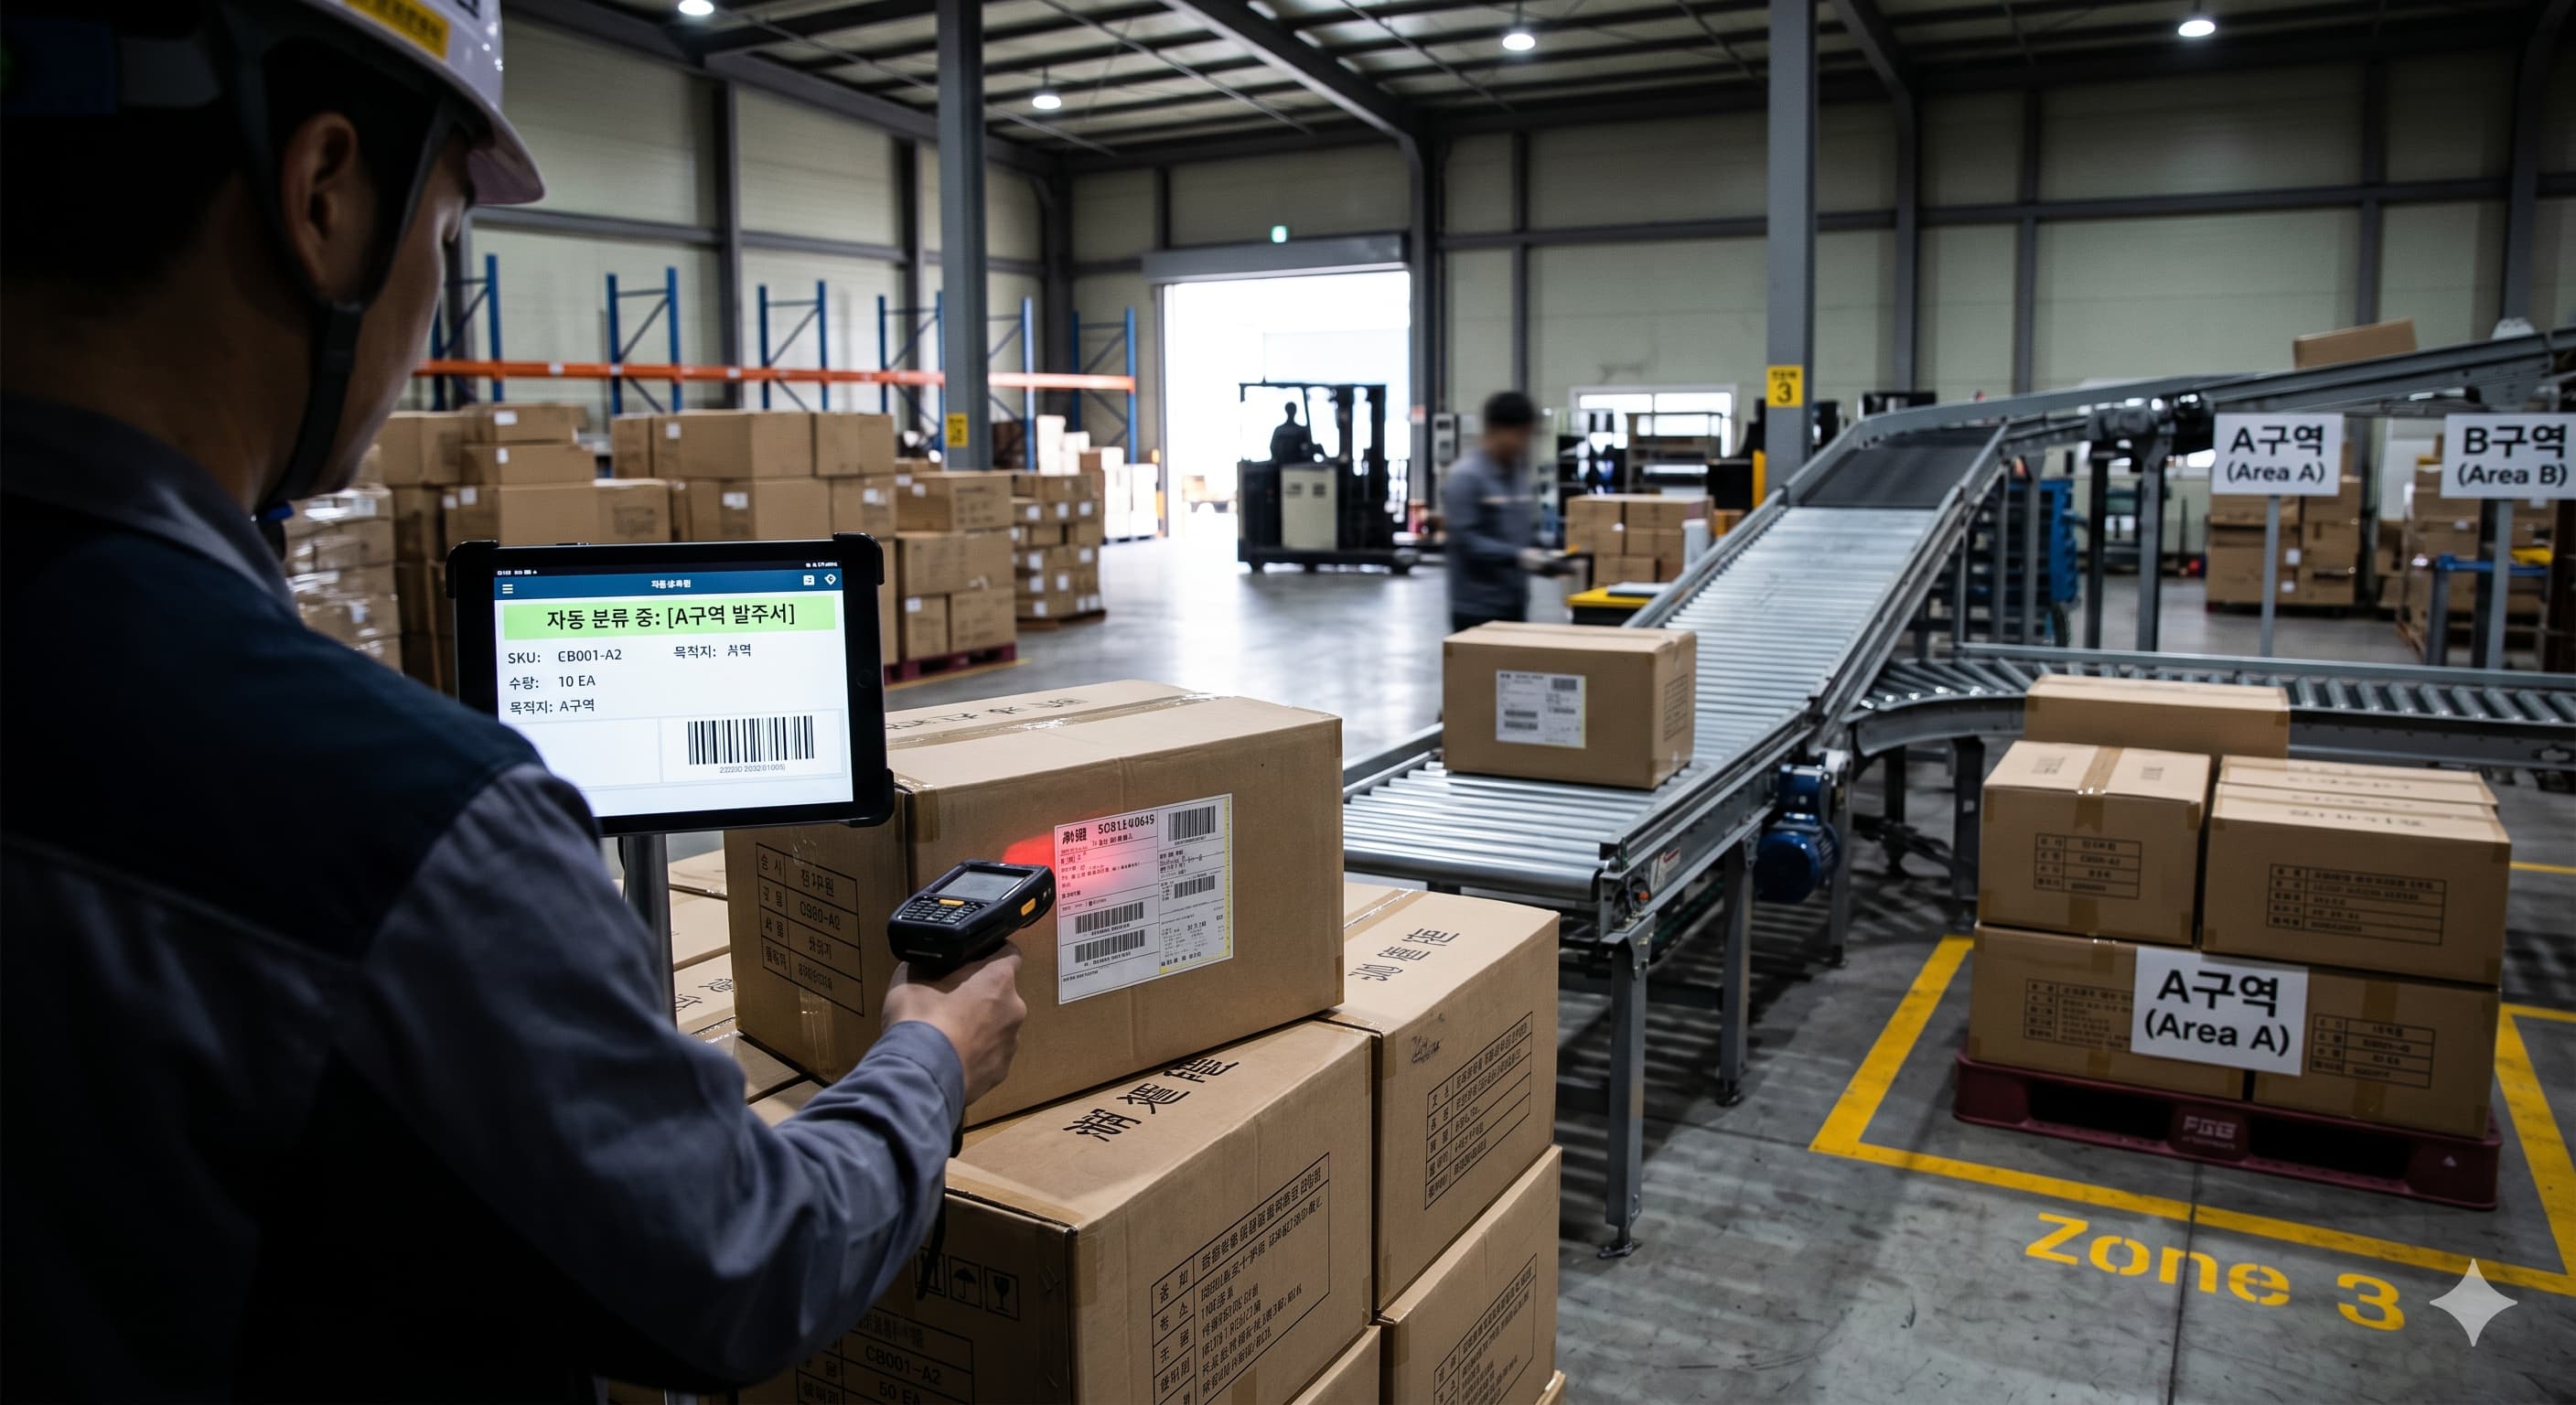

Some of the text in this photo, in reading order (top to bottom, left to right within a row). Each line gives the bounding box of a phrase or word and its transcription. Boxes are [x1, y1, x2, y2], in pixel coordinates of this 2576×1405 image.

[1776, 381, 1792, 403] 3
[2229, 424, 2324, 456] A구역
[2463, 424, 2568, 458] B구역
[2227, 461, 2324, 484] (Area A)
[2457, 463, 2568, 488] (Area B)
[547, 602, 795, 630] 자동 분류 중: [A구역 발주서]
[508, 651, 542, 665] SKU:
[559, 675, 574, 688] 10
[578, 674, 596, 687] EA
[559, 698, 596, 713] A구역
[2156, 969, 2279, 1018] A구역
[2144, 1008, 2238, 1047] (Area
[2249, 1024, 2291, 1057] A)
[2024, 1212, 2406, 1331] Zone 3
